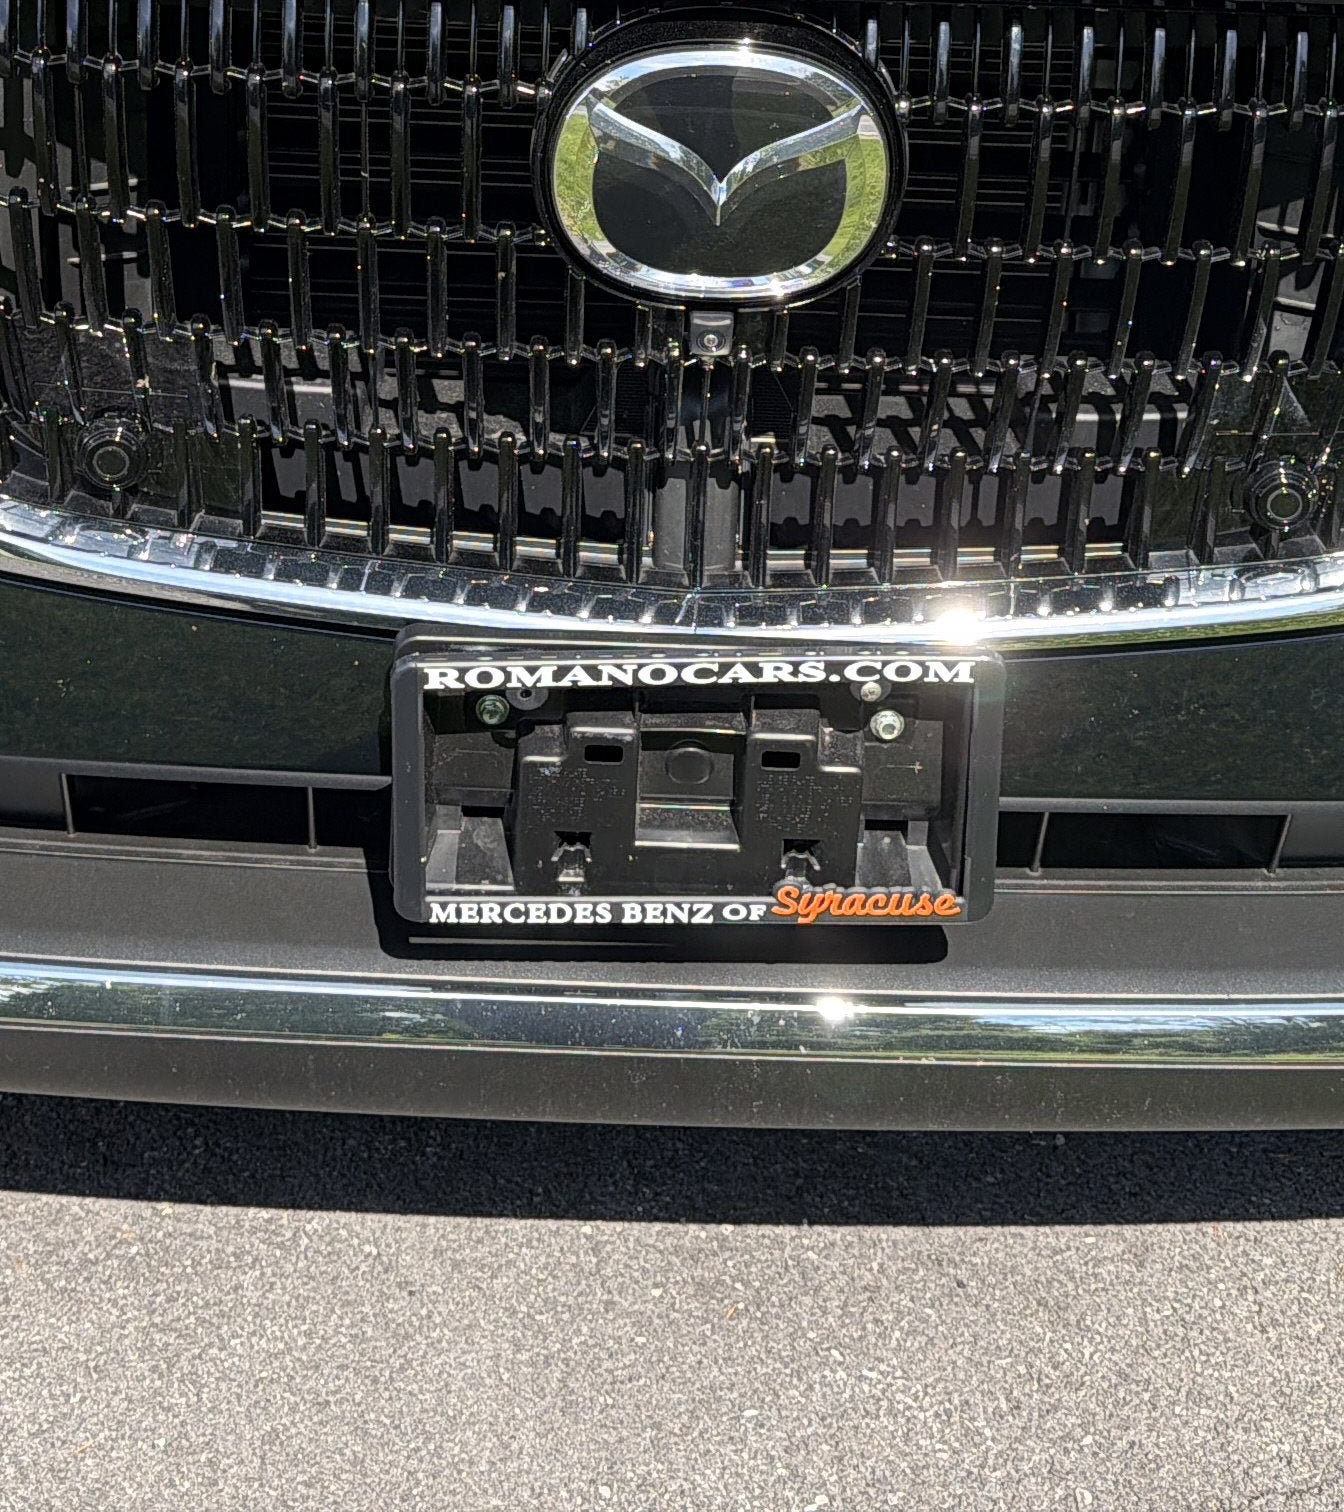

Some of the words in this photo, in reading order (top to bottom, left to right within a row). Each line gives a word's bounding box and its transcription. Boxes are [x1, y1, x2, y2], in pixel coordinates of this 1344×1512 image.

[423, 660, 976, 690] ROMANOCARS.COM
[428, 902, 612, 925] MERCEDES
[621, 903, 714, 925] BENZ
[722, 905, 766, 925] OF
[771, 886, 960, 924] Syracuse
